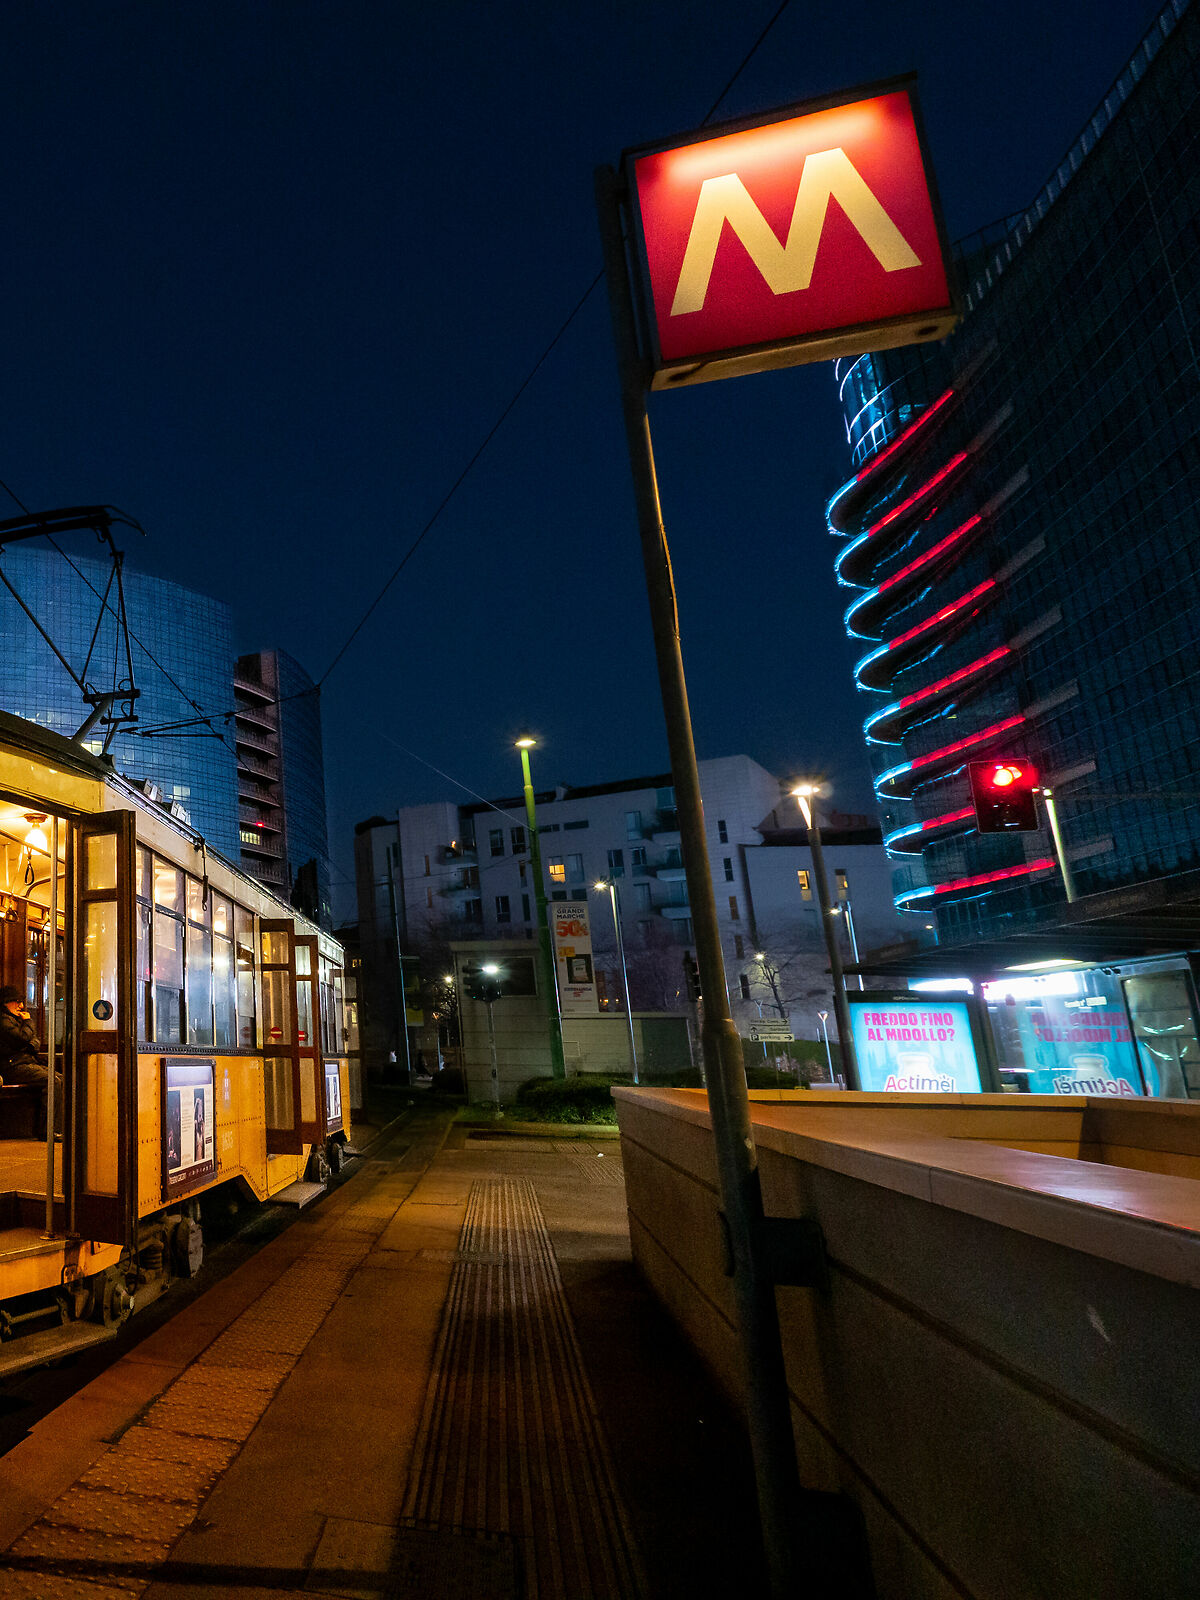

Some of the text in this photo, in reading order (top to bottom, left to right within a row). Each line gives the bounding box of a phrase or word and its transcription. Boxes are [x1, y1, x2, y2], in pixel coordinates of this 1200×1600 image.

[670, 147, 923, 318] M
[864, 1012, 954, 1026] FREDDO FINO
[868, 1028, 955, 1042] AL MIDOLLO?
[885, 1074, 954, 1092] Actimel
